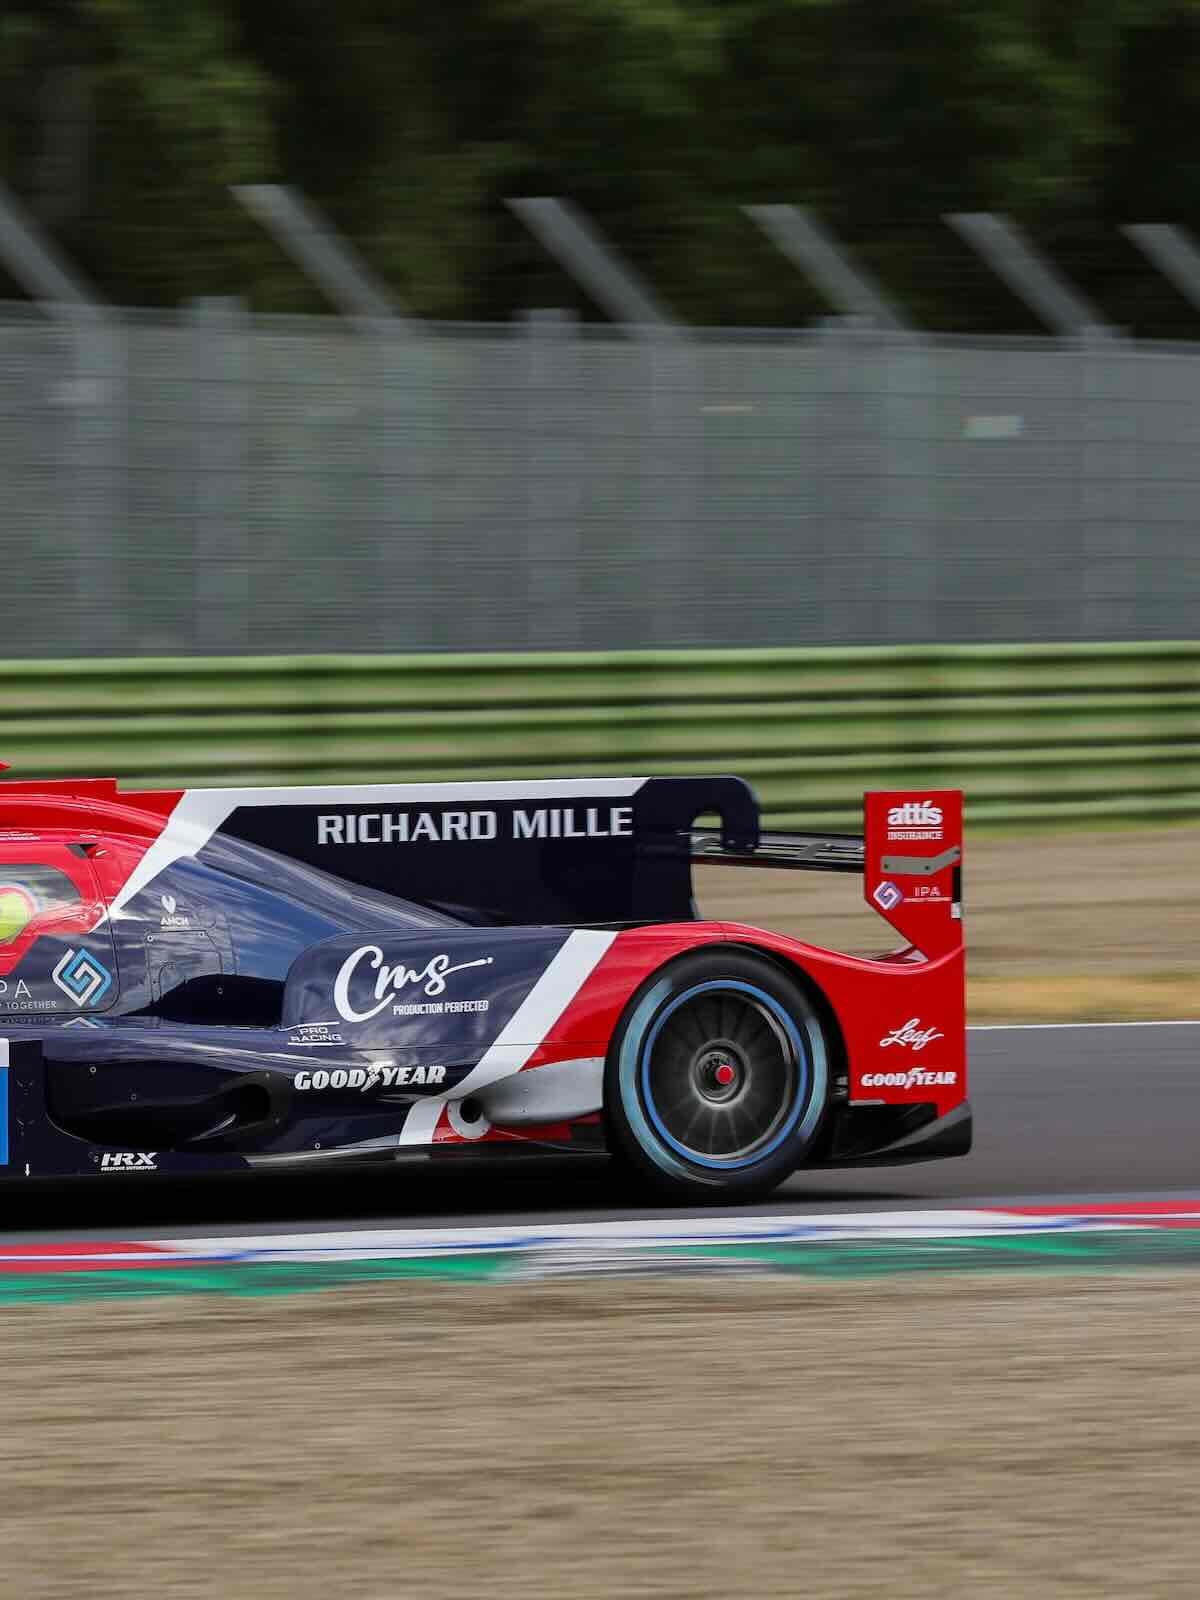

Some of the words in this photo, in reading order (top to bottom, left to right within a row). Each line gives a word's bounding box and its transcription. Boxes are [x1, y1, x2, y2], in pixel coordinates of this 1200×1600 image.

[317, 811, 497, 844] RICHARD
[512, 807, 633, 839] MILLE
[913, 886, 941, 897] IPA
[6, 1001, 57, 1009] TOGETHER
[393, 1003, 443, 1015] PRODUCTION
[445, 1000, 489, 1013] PERFECTED
[290, 1034, 342, 1042] RACING
[300, 1027, 328, 1035] PRO
[294, 1062, 446, 1092] GOODYEAR
[861, 1067, 956, 1089] GOODYEAR
[101, 1152, 158, 1166] HRX
